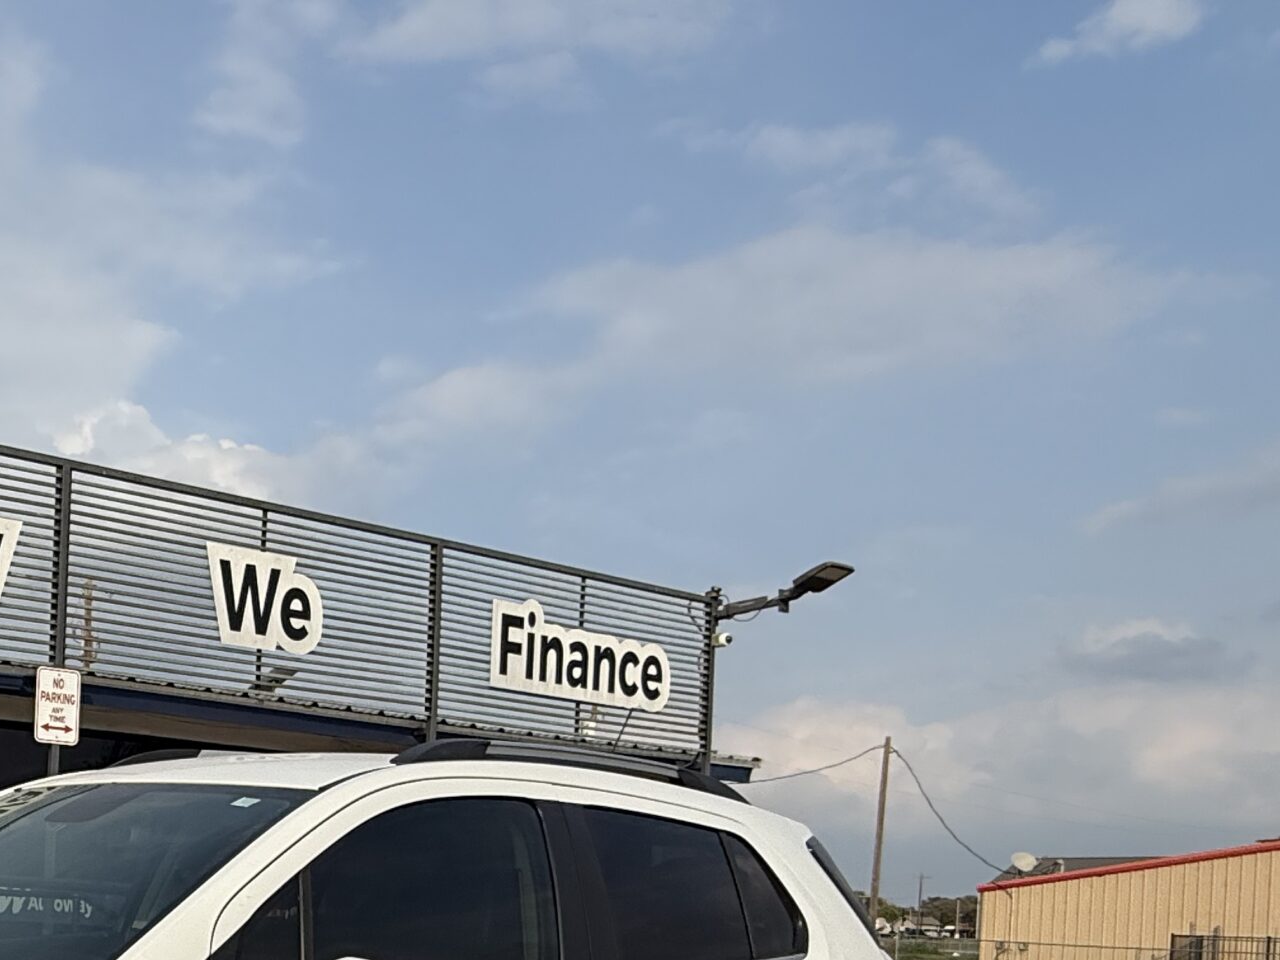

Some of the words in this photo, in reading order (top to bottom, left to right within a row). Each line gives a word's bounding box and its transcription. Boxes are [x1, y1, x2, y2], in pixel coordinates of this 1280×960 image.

[219, 559, 312, 641] We
[498, 611, 663, 701] Finance
[52, 678, 65, 689] NO
[40, 690, 76, 705] PARKING
[48, 714, 66, 723] TIME
